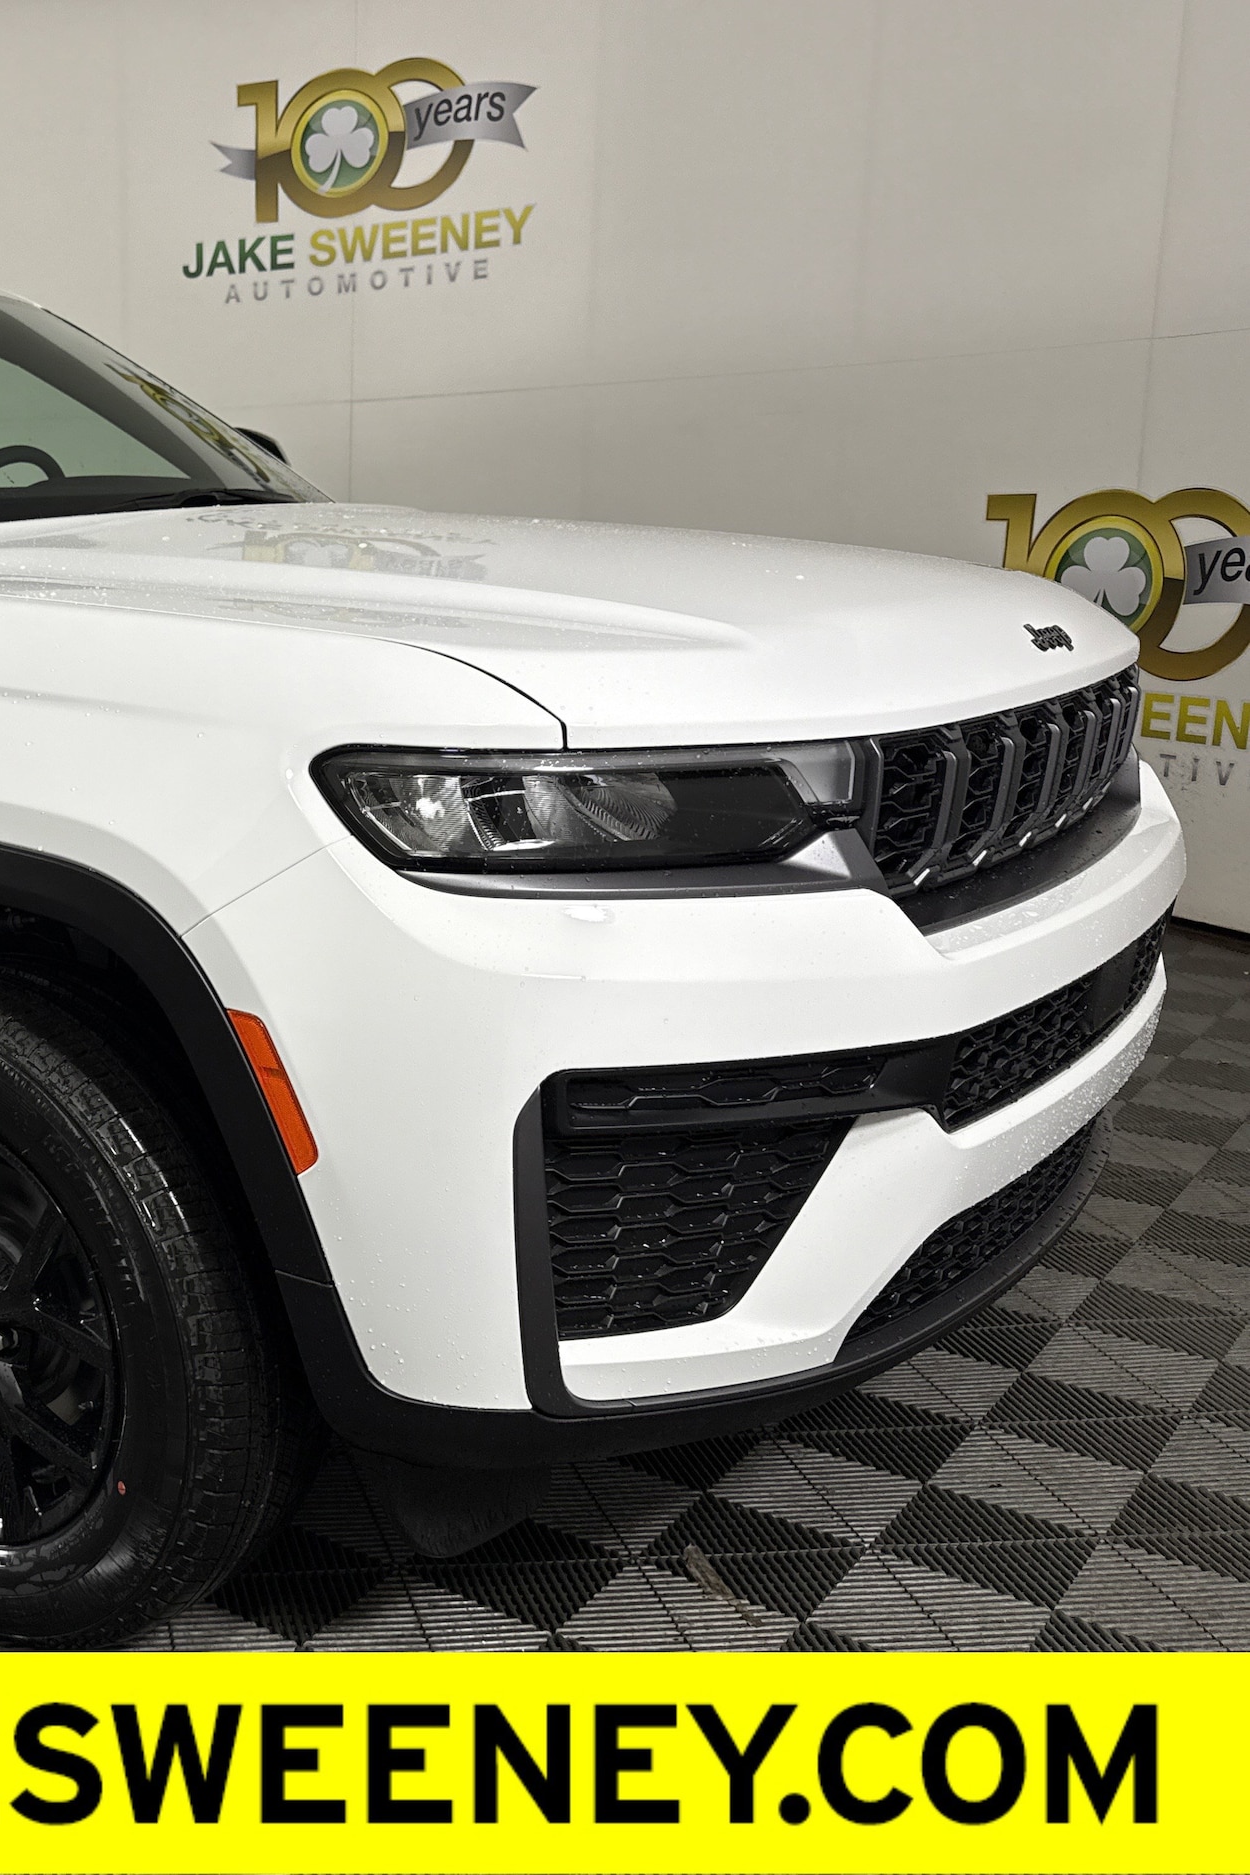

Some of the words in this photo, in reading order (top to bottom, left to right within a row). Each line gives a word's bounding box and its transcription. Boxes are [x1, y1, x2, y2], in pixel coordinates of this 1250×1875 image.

[236, 56, 476, 224] 100
[412, 90, 507, 142] years
[181, 234, 296, 279] JAKE
[308, 203, 537, 267] SWEENEY
[224, 259, 490, 304] AUTOMOTIVE
